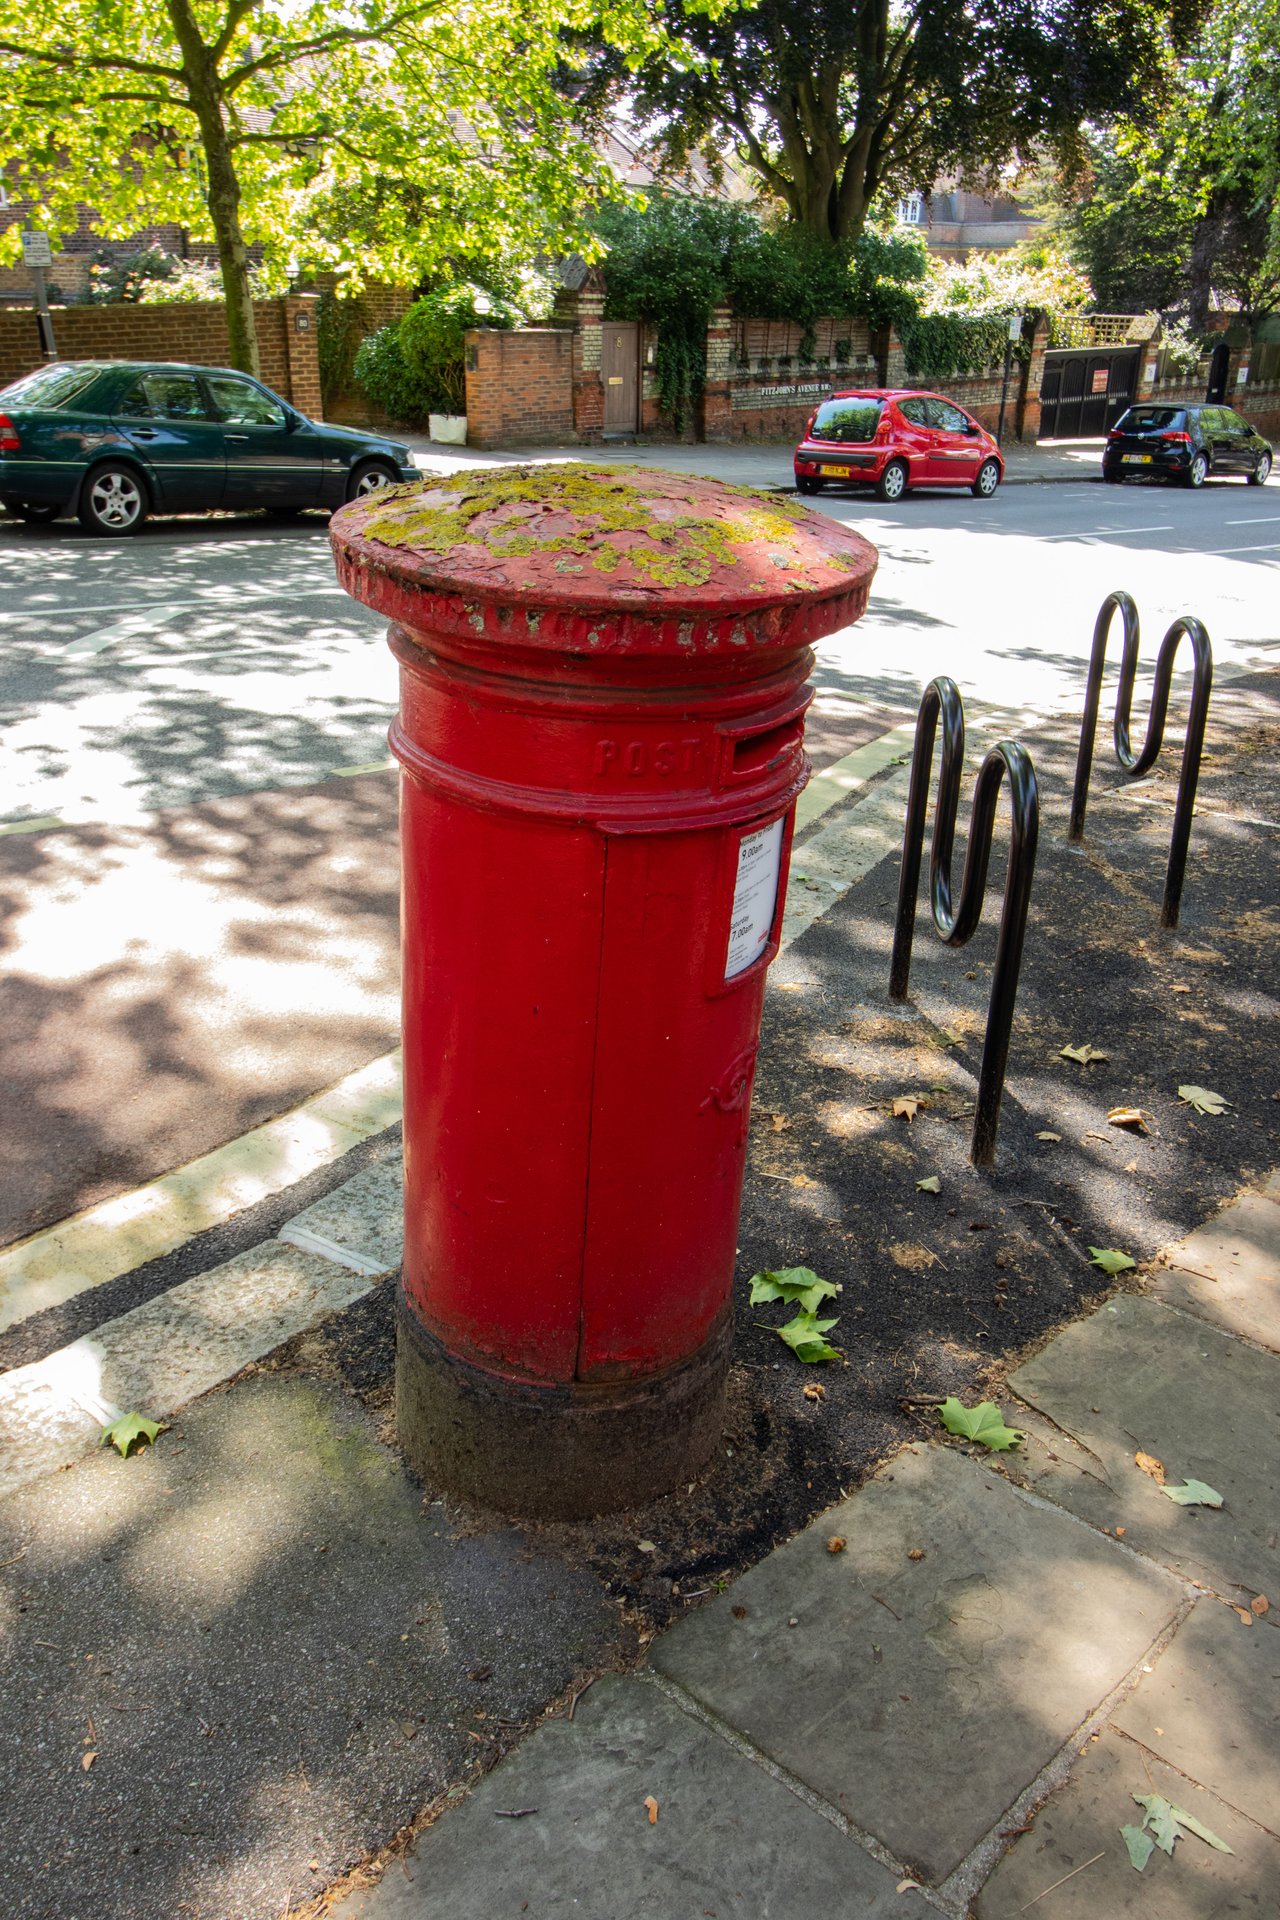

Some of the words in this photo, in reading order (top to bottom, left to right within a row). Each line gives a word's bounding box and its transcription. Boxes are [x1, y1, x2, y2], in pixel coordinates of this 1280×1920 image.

[761, 384, 796, 396] FITZJOHN'S
[797, 383, 820, 393] AVENUE
[594, 738, 700, 777] POST
[742, 844, 763, 861] 9.00am
[731, 915, 749, 929] Saturday
[732, 923, 753, 942] 7.00am
